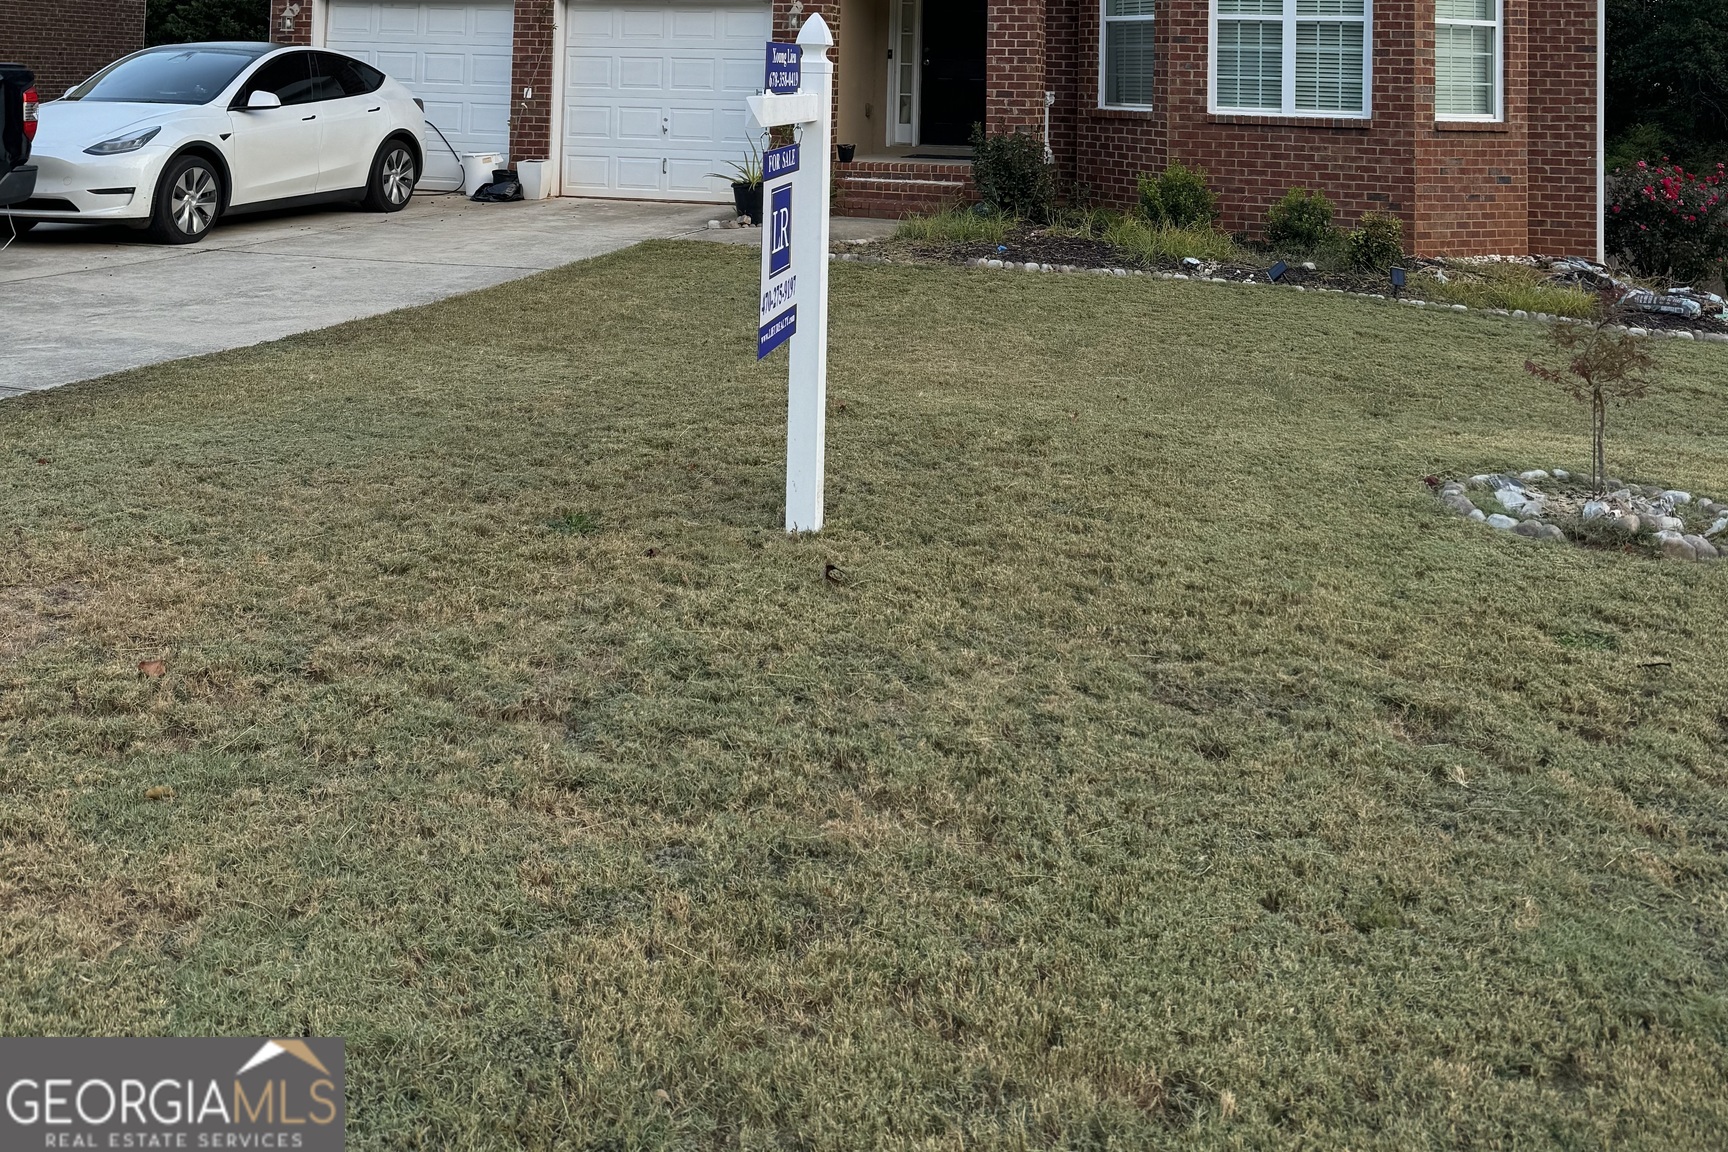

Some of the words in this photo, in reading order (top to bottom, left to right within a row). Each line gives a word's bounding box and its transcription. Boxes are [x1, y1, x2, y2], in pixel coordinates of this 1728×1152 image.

[768, 152, 780, 173] FOR
[782, 149, 795, 168] SALE
[772, 207, 789, 254] LR
[761, 275, 797, 316] 470-275-9197
